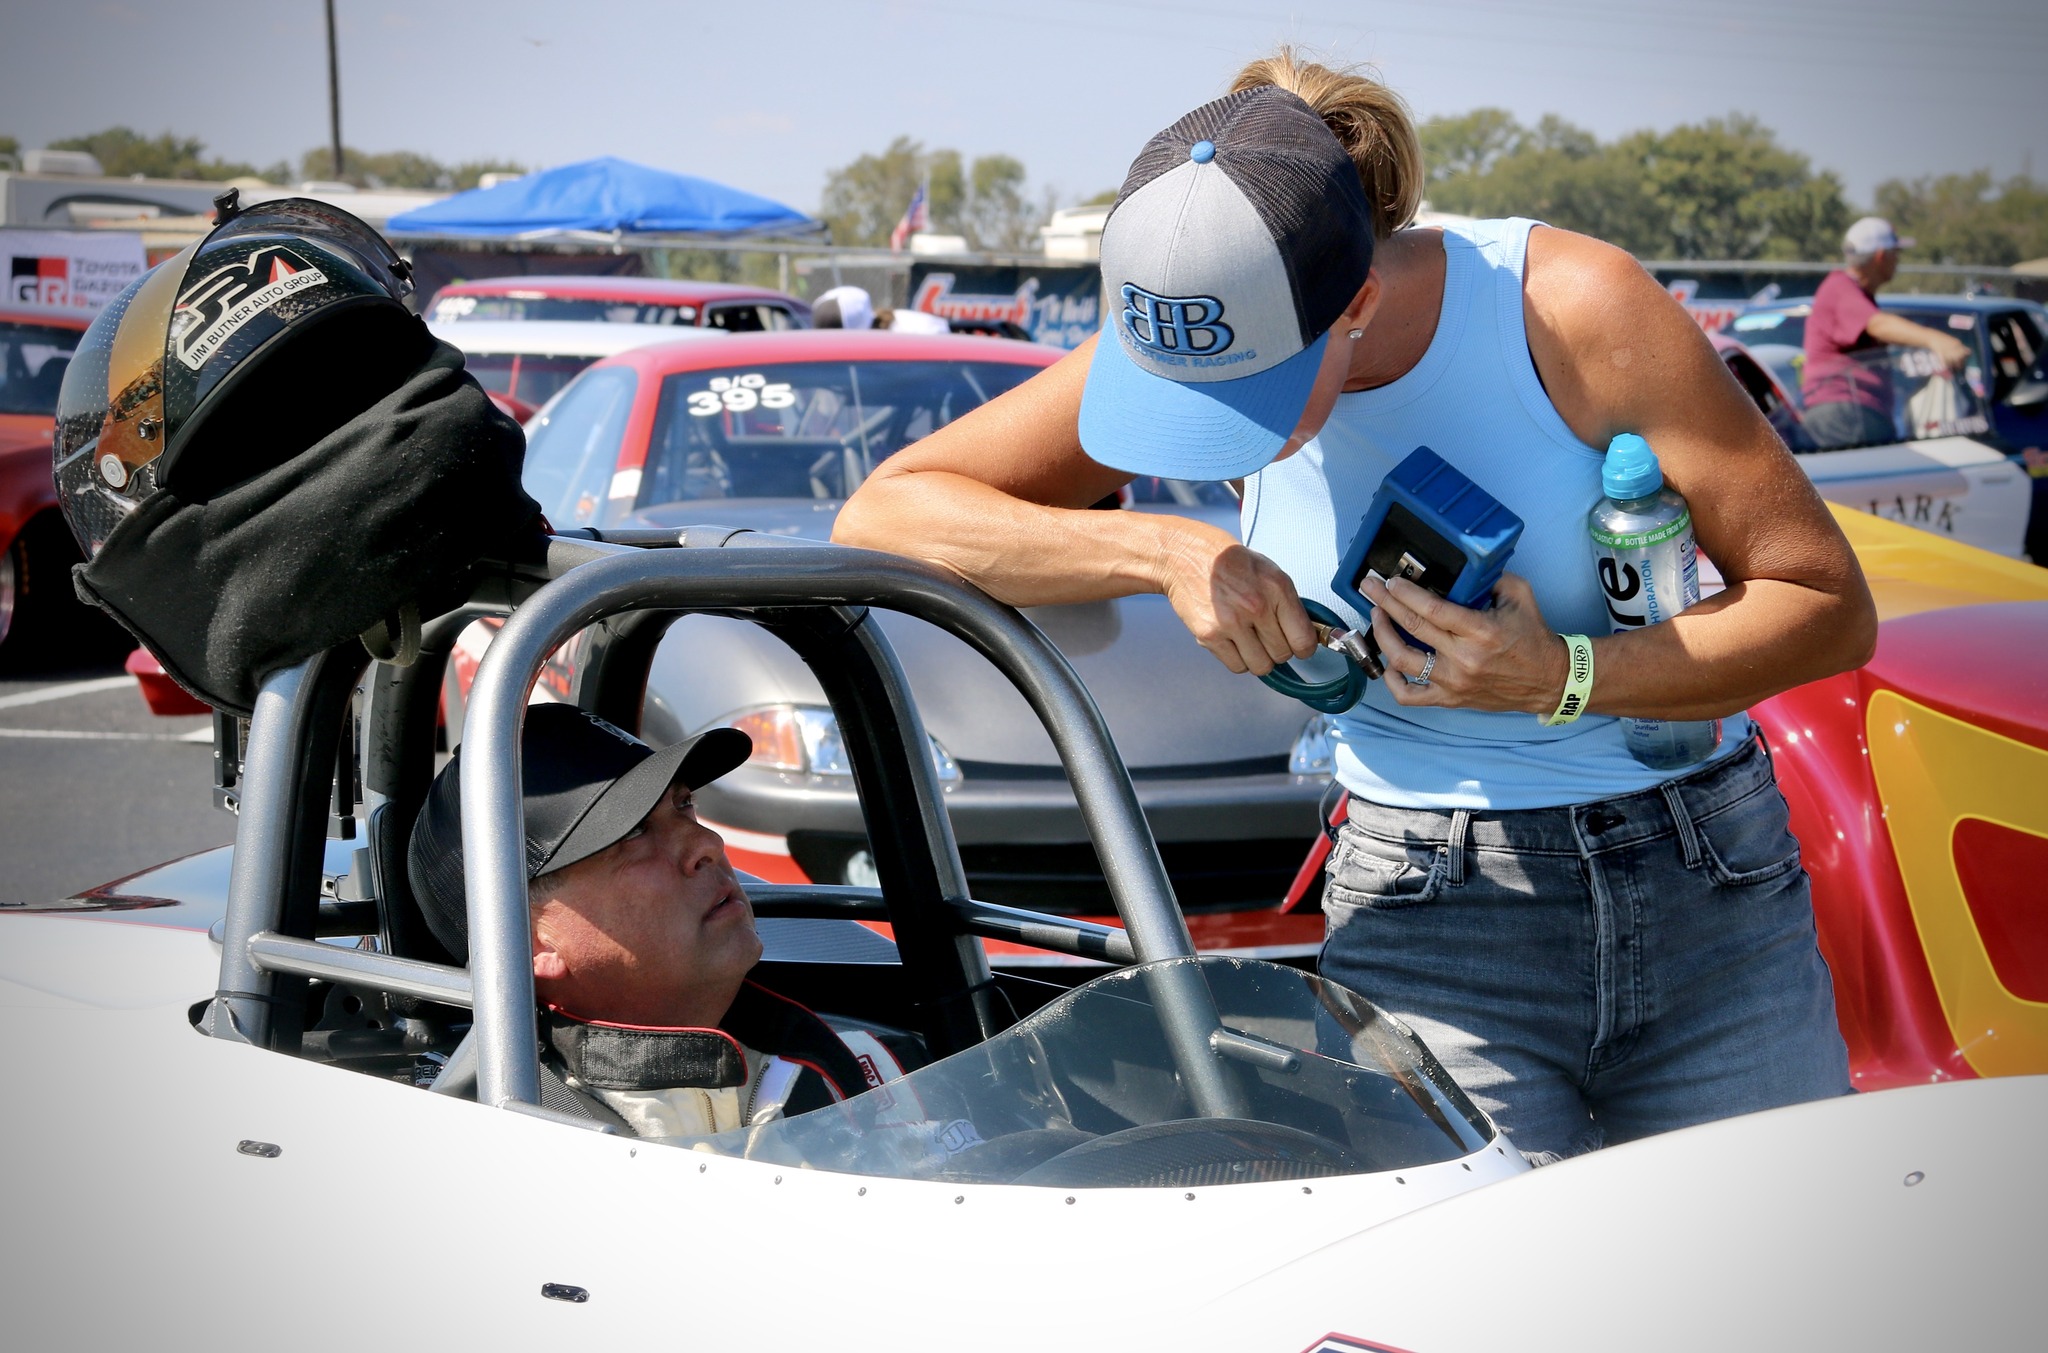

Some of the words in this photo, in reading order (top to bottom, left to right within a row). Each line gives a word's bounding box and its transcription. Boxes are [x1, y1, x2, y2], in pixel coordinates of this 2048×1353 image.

[74, 278, 126, 293] GAZO
[190, 344, 210, 365] JIM
[206, 306, 253, 346] BUTNER
[253, 286, 284, 310] AUTO
[283, 271, 322, 291] GROUP
[1192, 348, 1257, 368] RACING
[687, 383, 795, 416] 395
[1625, 536, 1648, 546] BOTTLE
[1648, 531, 1667, 543] MADE
[1667, 524, 1680, 537] FROM
[1598, 557, 1646, 634] re
[1641, 559, 1661, 624] HYDRATION
[1576, 648, 1588, 680] NHRA
[1560, 693, 1581, 716] RAP
